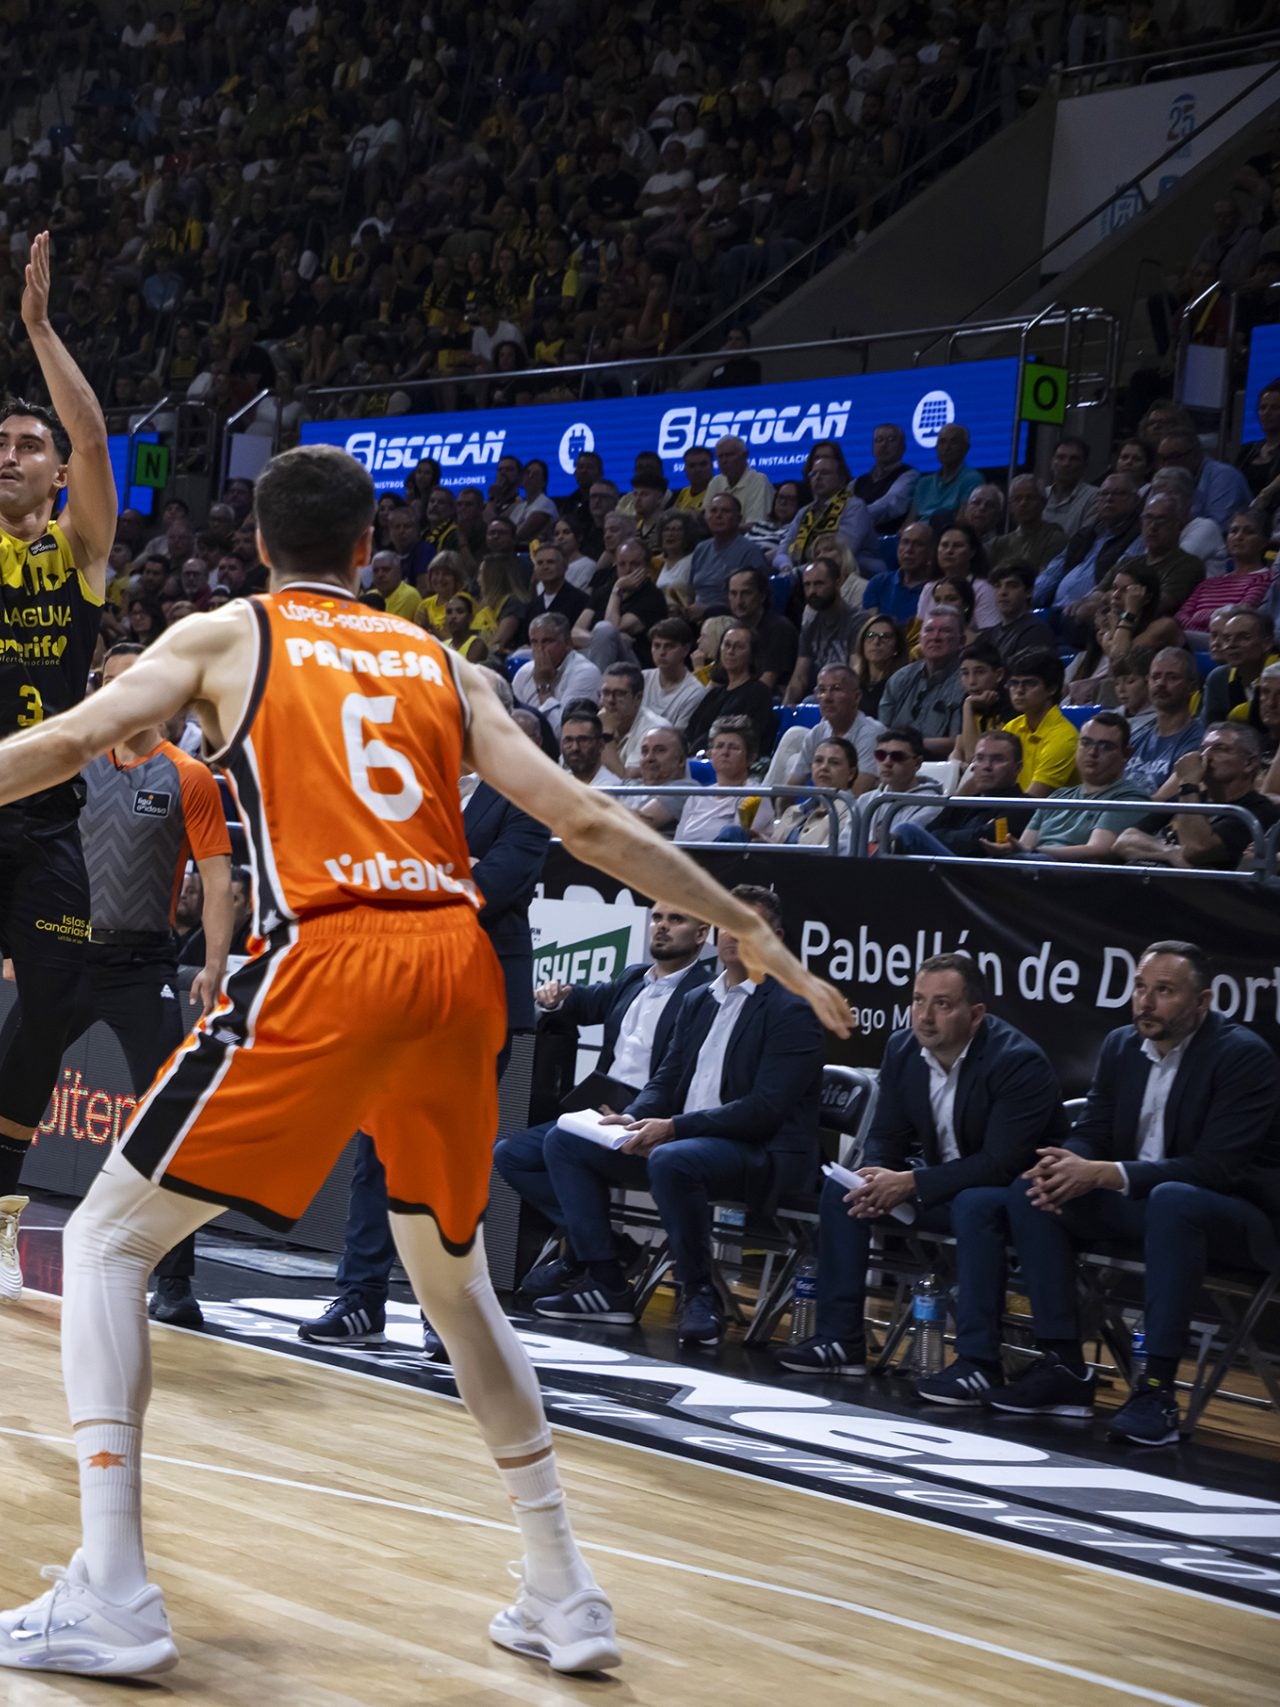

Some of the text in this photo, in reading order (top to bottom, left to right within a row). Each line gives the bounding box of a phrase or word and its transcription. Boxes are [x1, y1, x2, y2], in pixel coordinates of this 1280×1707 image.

[145, 451, 162, 480] N
[284, 637, 444, 688] PAMESA
[17, 684, 44, 728] 3
[341, 693, 423, 822] 6
[35, 919, 85, 937] Canarias
[800, 919, 1004, 997] Pabeln
[1019, 941, 1080, 1004] de
